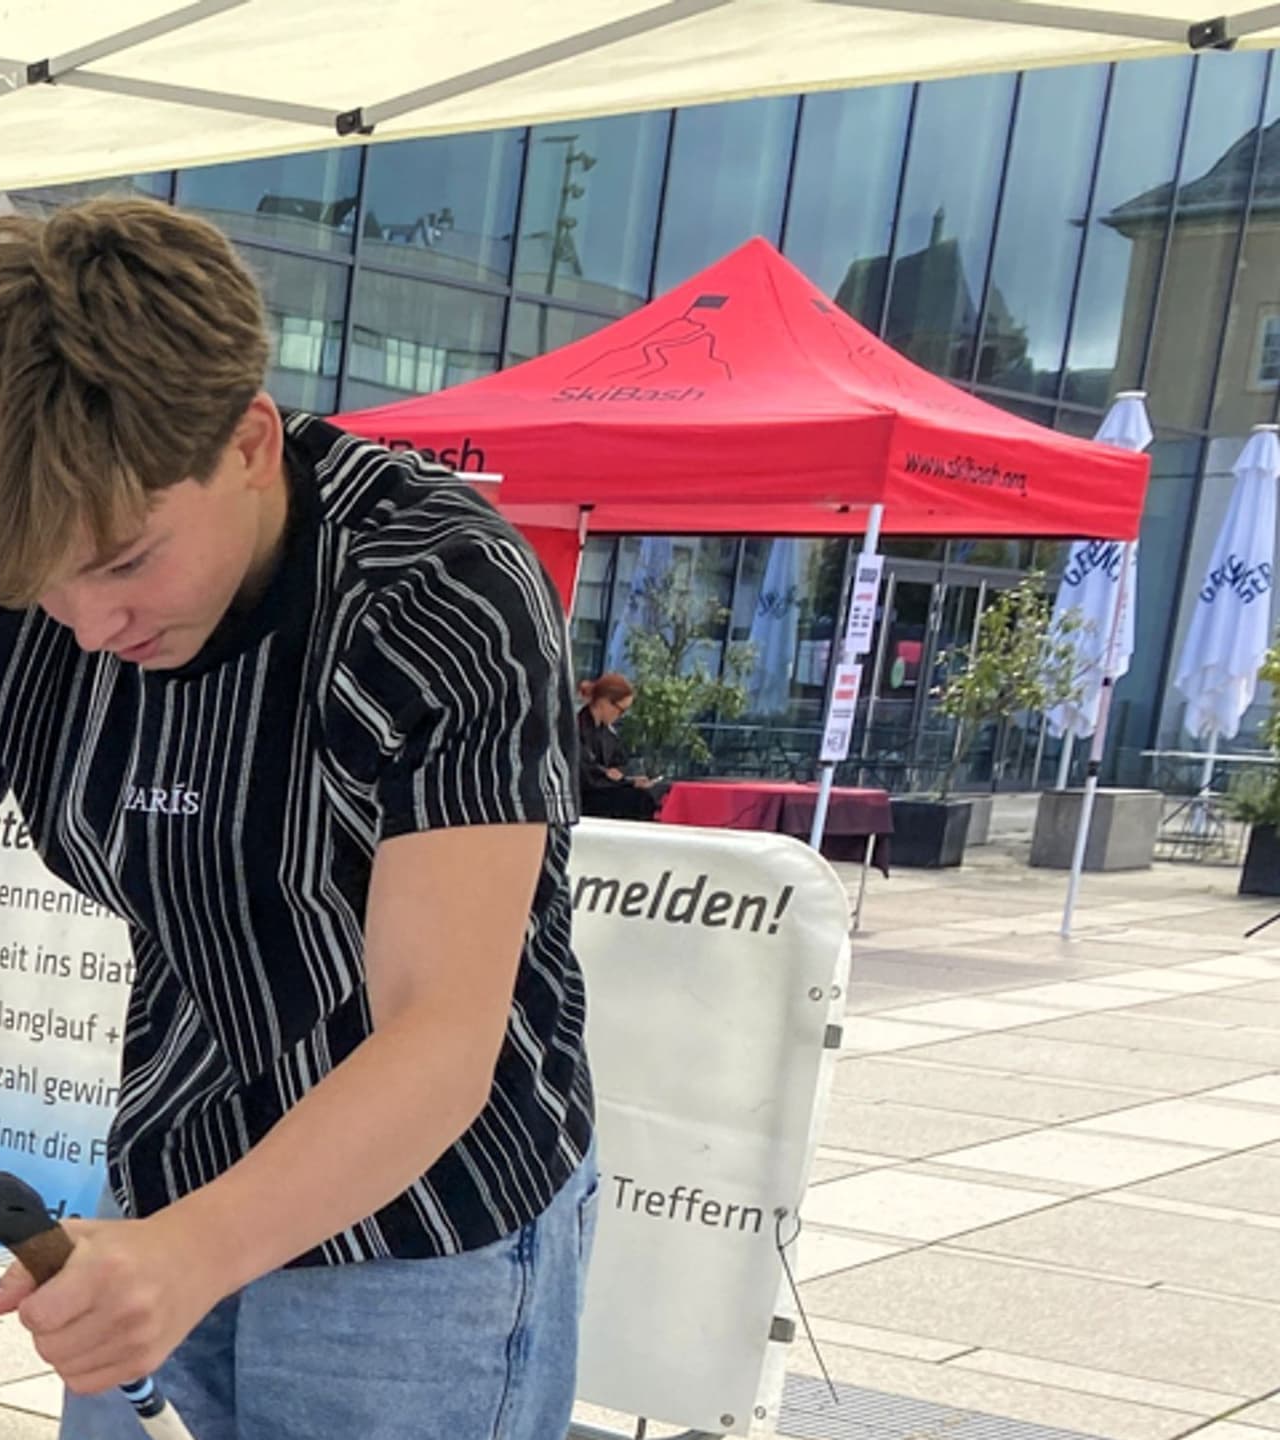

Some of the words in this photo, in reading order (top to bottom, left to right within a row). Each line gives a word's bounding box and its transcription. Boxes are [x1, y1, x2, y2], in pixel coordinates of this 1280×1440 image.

[552, 385, 706, 402] SkiBash
[904, 453, 1028, 497] www.skibash.org
[573, 871, 795, 935] melden!
[34, 945, 72, 978] ins
[80, 951, 138, 985] Biat
[43, 1130, 81, 1164] die
[613, 1175, 764, 1234] Treffern
